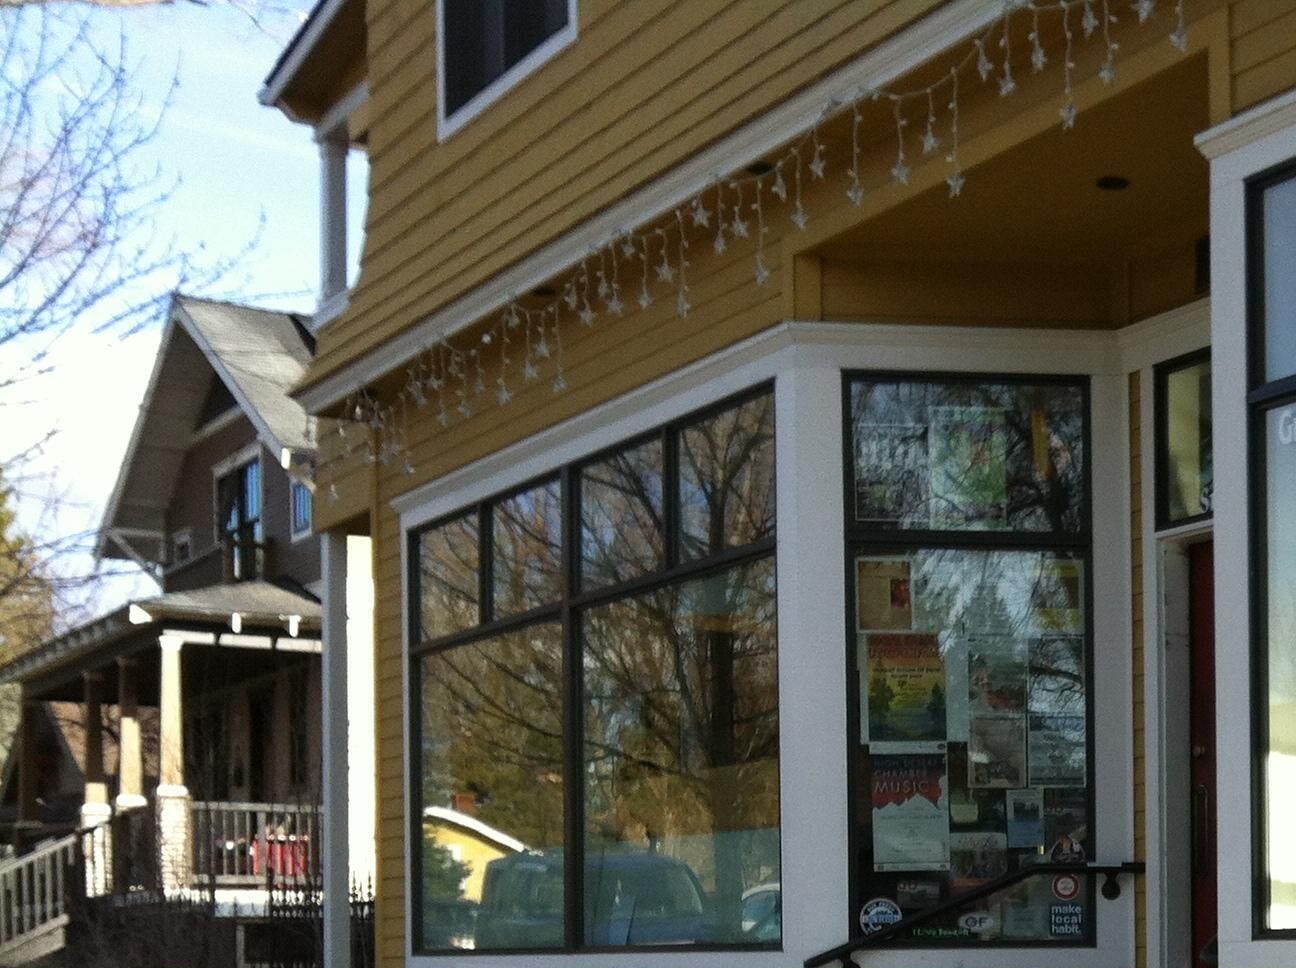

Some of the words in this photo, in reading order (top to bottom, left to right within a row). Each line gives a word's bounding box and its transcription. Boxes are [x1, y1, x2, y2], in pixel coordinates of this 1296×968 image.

[873, 780, 929, 794] MUSIC
[1051, 904, 1082, 914] make
[1051, 914, 1082, 924] local
